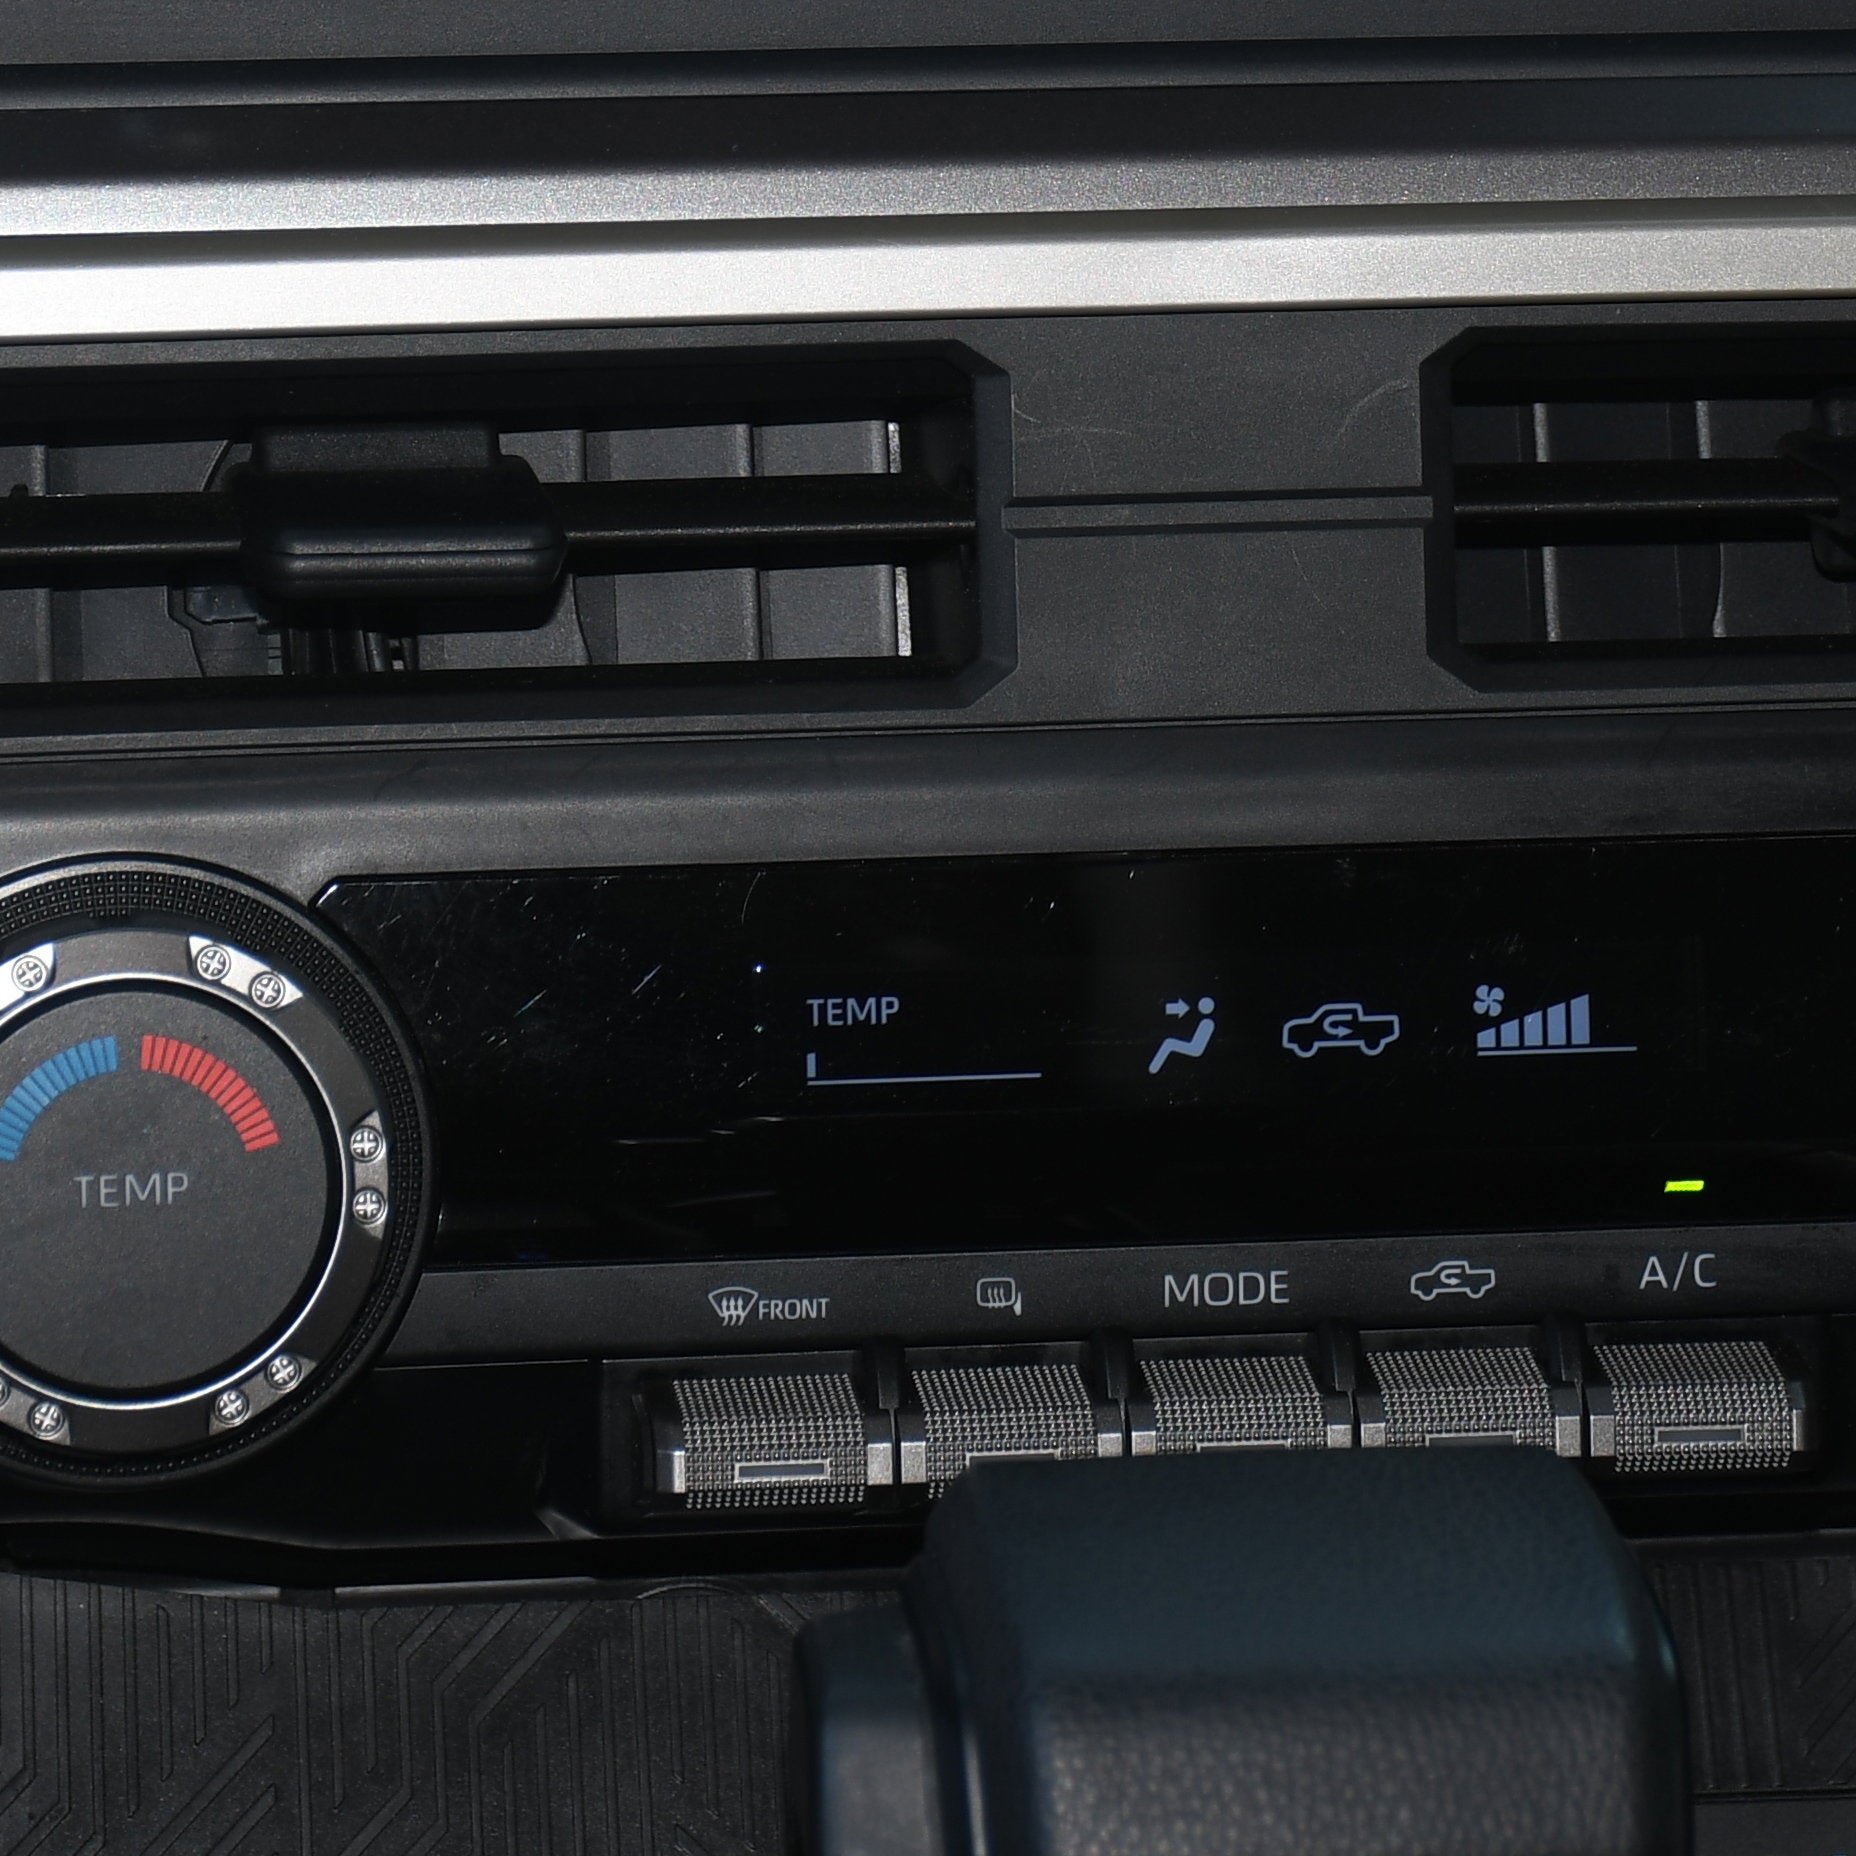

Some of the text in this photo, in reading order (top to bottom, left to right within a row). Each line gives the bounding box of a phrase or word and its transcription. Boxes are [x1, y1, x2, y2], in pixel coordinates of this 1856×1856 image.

[806, 996, 901, 1027] TEMP
[74, 1171, 190, 1208] TEMP
[1162, 1269, 1291, 1308] MODE
[1638, 1252, 1718, 1291] A/C
[757, 1295, 831, 1321] FRONT
